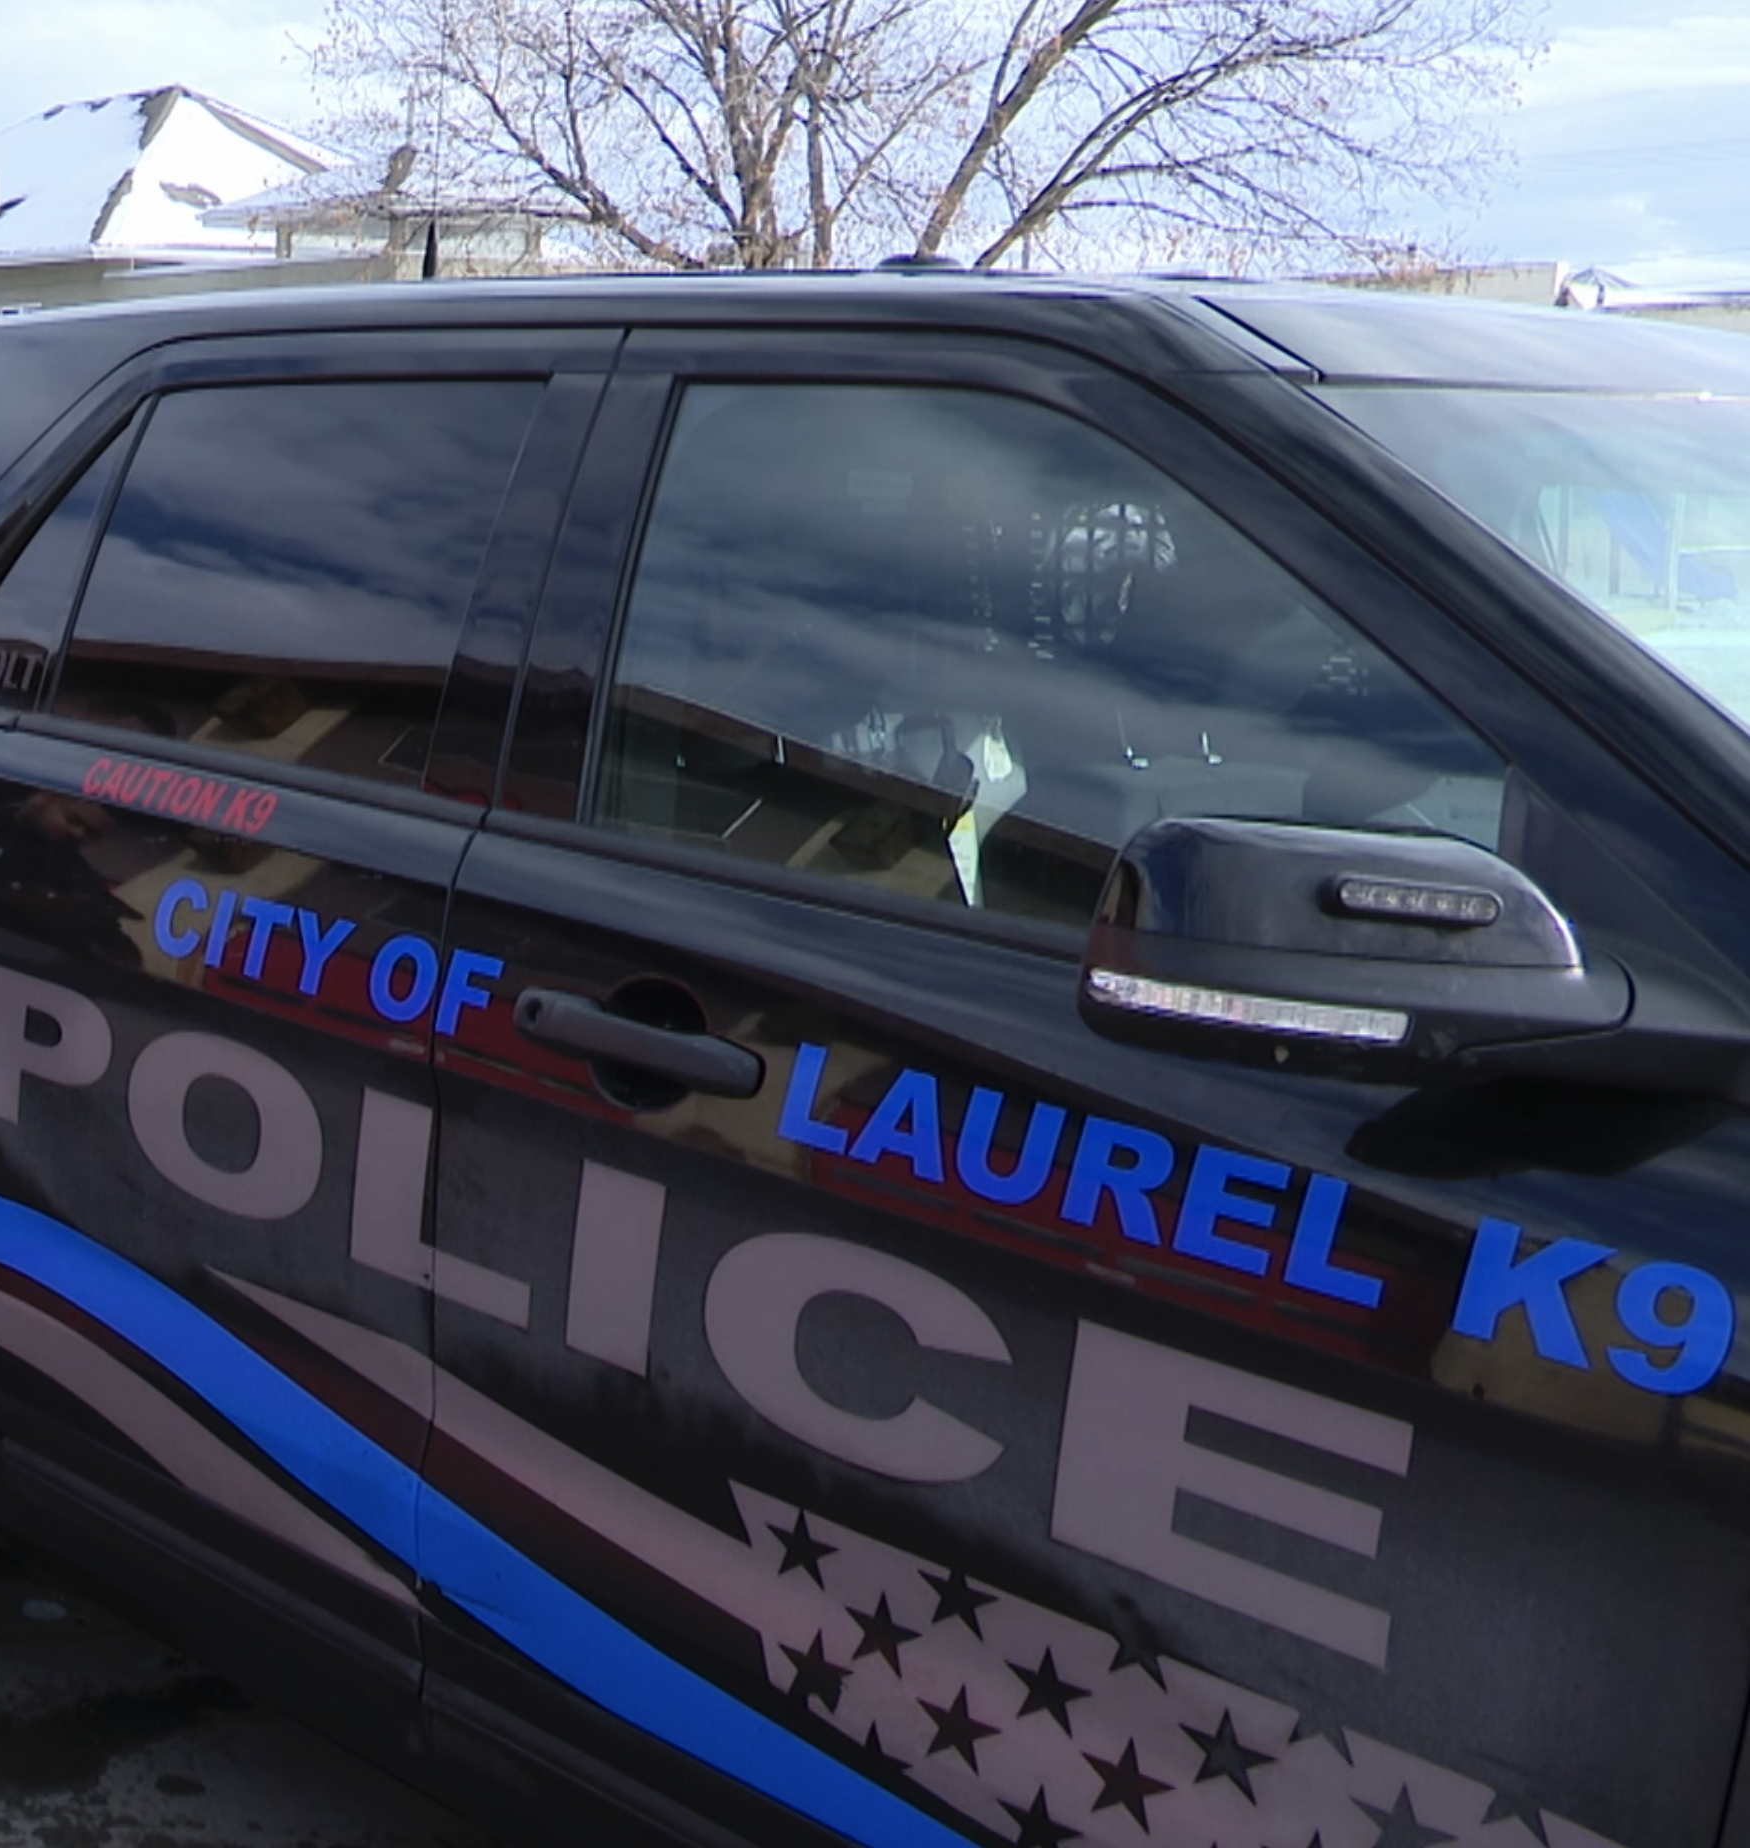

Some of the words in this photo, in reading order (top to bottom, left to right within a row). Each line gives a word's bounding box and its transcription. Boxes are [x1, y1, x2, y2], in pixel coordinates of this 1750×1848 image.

[82, 756, 227, 823] CAUTION
[221, 786, 278, 834] K9
[154, 878, 356, 996] CITY
[368, 933, 506, 1036] OF
[776, 1041, 1385, 1309] LAUREL
[1450, 1215, 1738, 1396] K9
